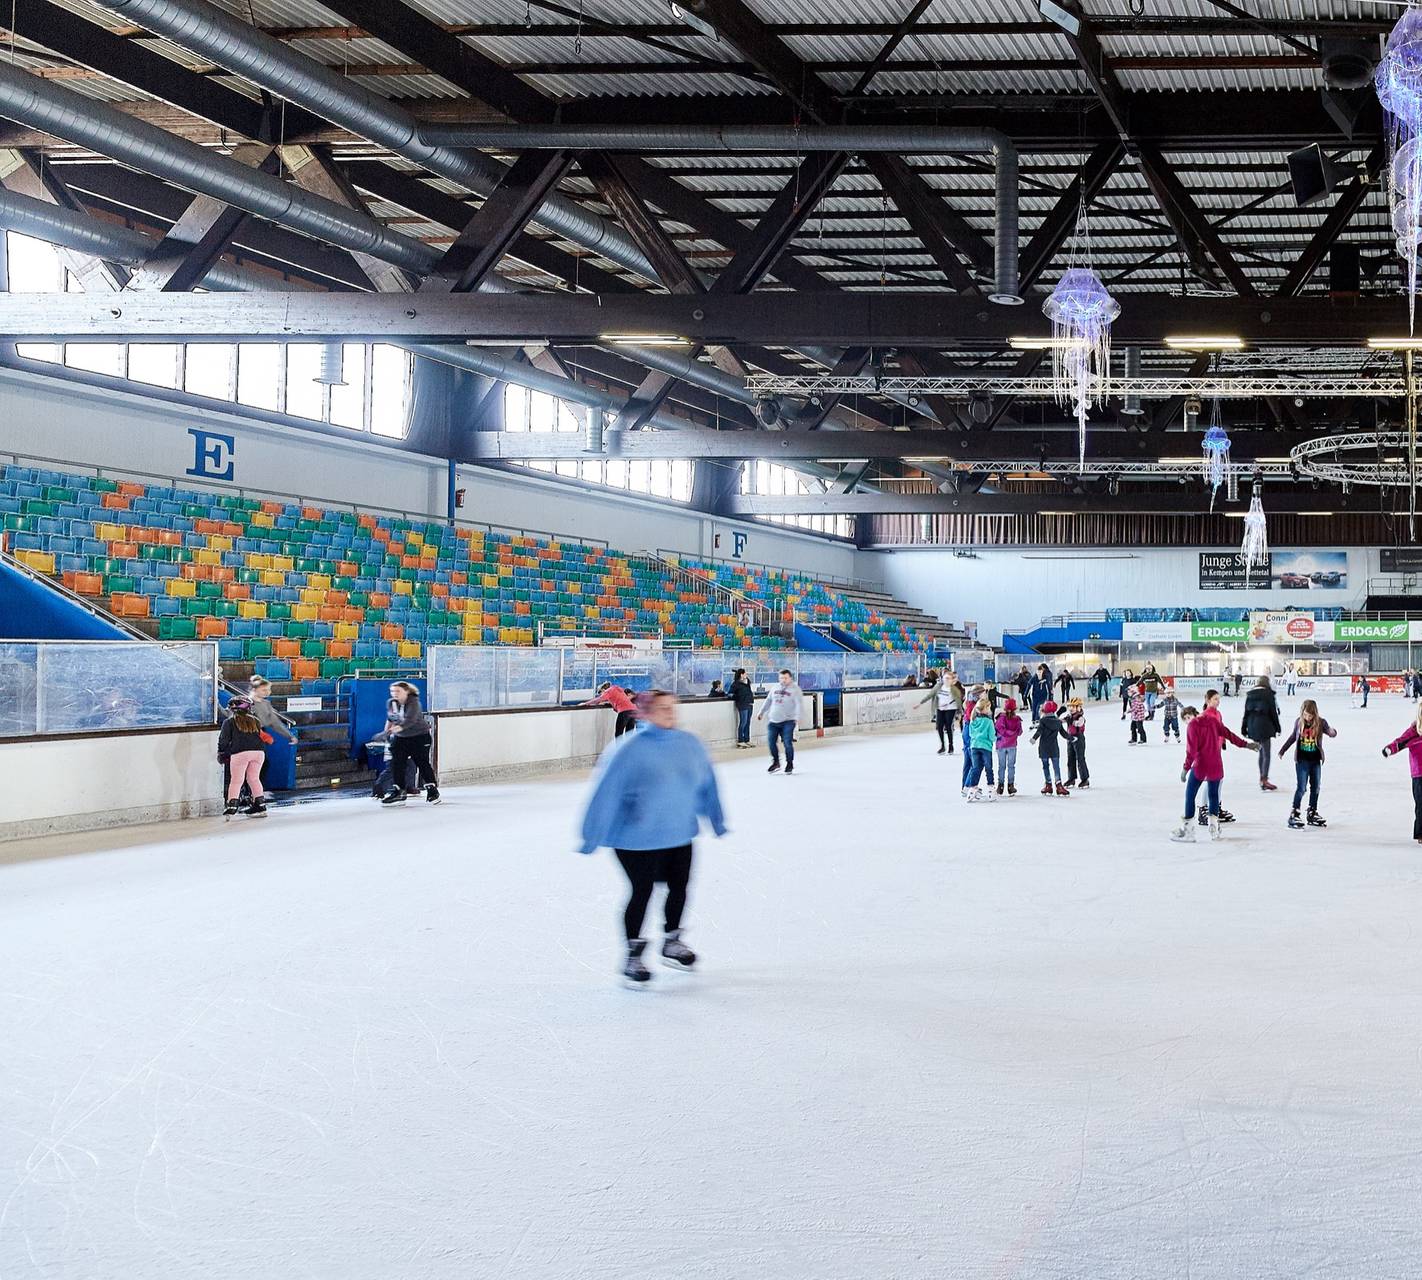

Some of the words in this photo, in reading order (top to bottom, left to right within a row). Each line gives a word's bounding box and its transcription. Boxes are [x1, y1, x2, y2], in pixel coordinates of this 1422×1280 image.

[186, 428, 234, 481] E
[732, 531, 747, 558] F
[1202, 554, 1232, 569] Junge
[1208, 569, 1233, 578] Kempen
[1234, 568, 1246, 576] und
[1265, 613, 1289, 622] Conni
[1197, 627, 1245, 637] ERDGAS
[1340, 626, 1388, 636] ERDGAS
